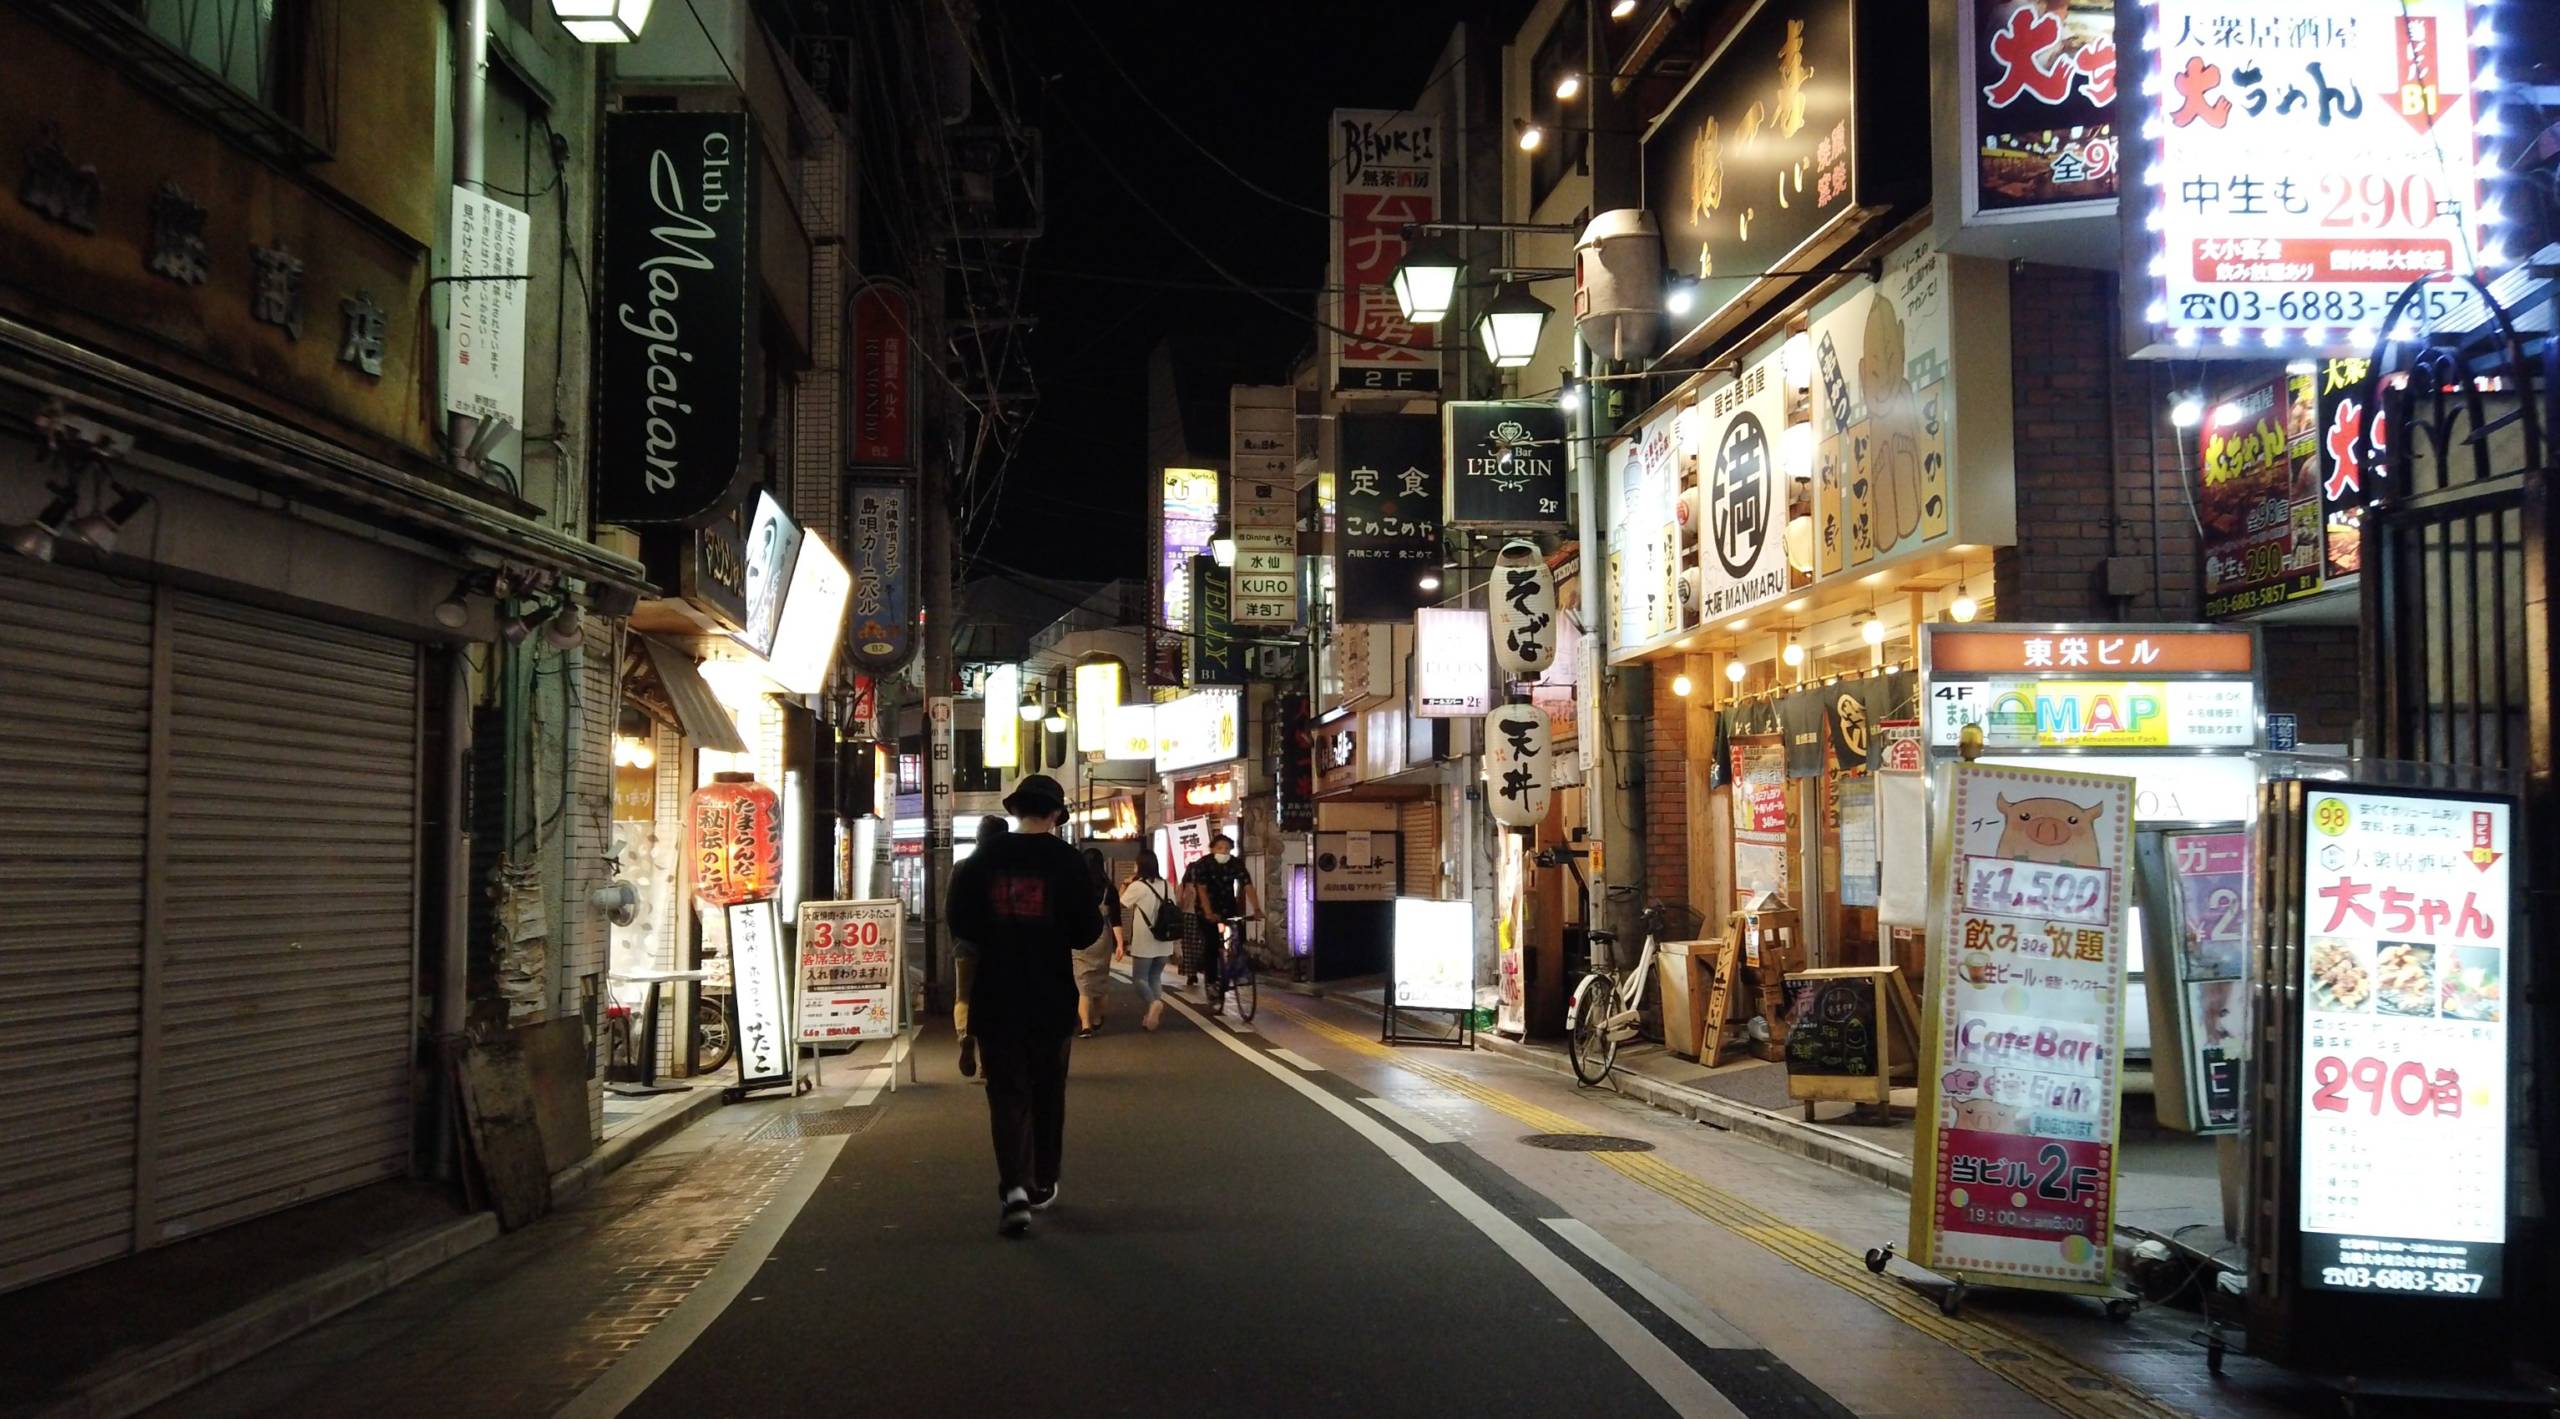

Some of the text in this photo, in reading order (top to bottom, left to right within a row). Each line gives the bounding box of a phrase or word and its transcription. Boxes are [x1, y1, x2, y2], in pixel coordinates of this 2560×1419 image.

[2175, 14, 2358, 48] 大衆居酒屋
[2406, 19, 2429, 81] 当ビル
[2169, 56, 2363, 129] 大ちゃん
[2400, 83, 2437, 116] B1
[1342, 119, 1434, 185] BENKEI
[2050, 137, 2117, 183] 全9
[702, 131, 730, 214] Club
[1362, 170, 1430, 188] 無茶酒房
[2181, 173, 2310, 215] 中生も
[618, 149, 716, 497] Magician
[1364, 371, 1413, 388] 2F
[1466, 458, 1552, 476] L'ECRIN
[1515, 447, 1533, 458] Bar
[1349, 465, 1431, 498] 定食
[1539, 498, 1559, 514] 2F
[1346, 516, 1433, 538] こめこめや
[857, 497, 881, 616] 島唄カーニバル
[1251, 555, 1280, 569] 水仙
[1241, 579, 1288, 593] KURO
[1704, 567, 1785, 619] 大阪 MANMARU
[1204, 572, 1228, 670] JELLY
[1246, 603, 1285, 617] 洋包丁
[1504, 569, 1550, 662] そば
[2023, 637, 2160, 667] 東栄ビル
[1202, 669, 1216, 680] B1
[1466, 696, 1482, 708] 2F
[1935, 686, 1974, 700] 4F
[2082, 735, 2135, 743] Amusement
[2138, 735, 2158, 743] Park
[2278, 716, 2292, 751] 防犯カ
[1499, 719, 1542, 813] 天丼
[2319, 806, 2345, 827] 98
[2318, 876, 2495, 940] 大ちゃん
[1964, 918, 2017, 953] 飲み
[2045, 921, 2105, 962] 放題
[2033, 1025, 2094, 1063] Bar
[2028, 1074, 2096, 1114] Eight
[1951, 1143, 2099, 1203] 当ビル 2F
[2344, 1267, 2485, 1294] 03-6883-5857
